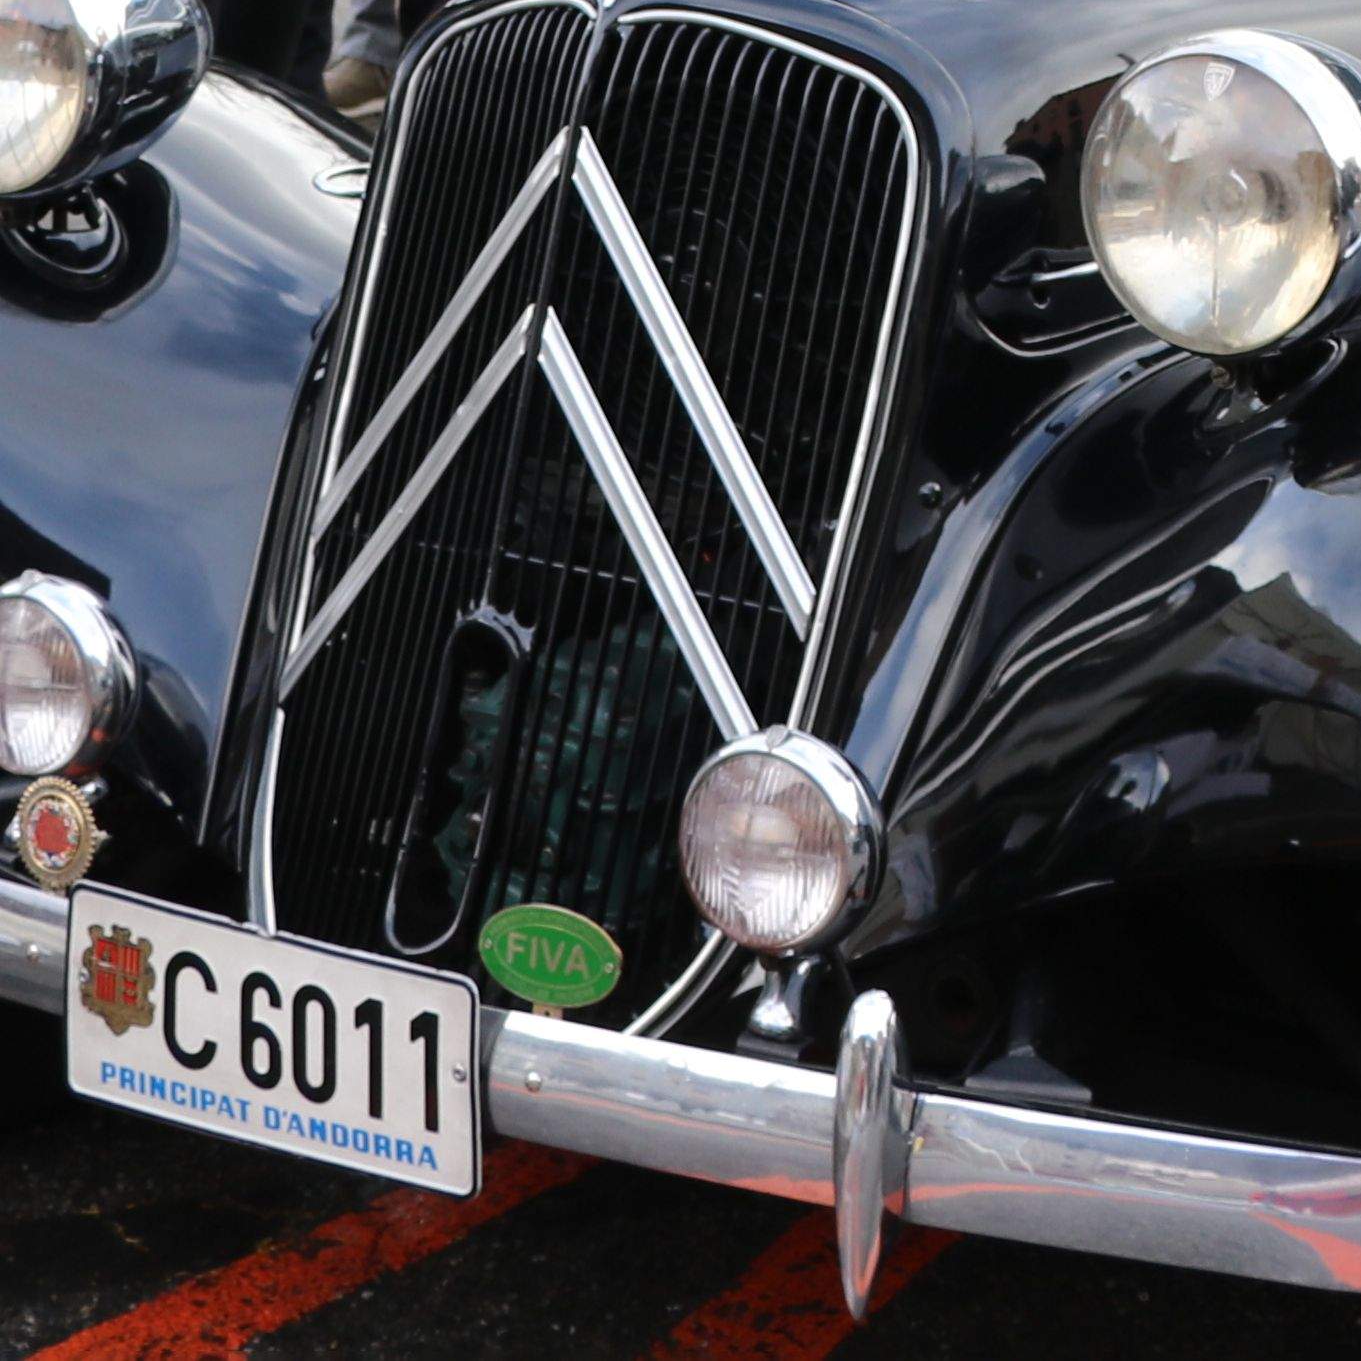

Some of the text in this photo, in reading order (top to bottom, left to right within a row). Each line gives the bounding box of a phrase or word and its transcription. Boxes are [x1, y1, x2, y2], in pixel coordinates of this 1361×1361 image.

[505, 931, 592, 981] FIVA
[163, 950, 440, 1133] C 6011
[100, 1060, 439, 1172] PRINCIPAT D'ANDORRA
